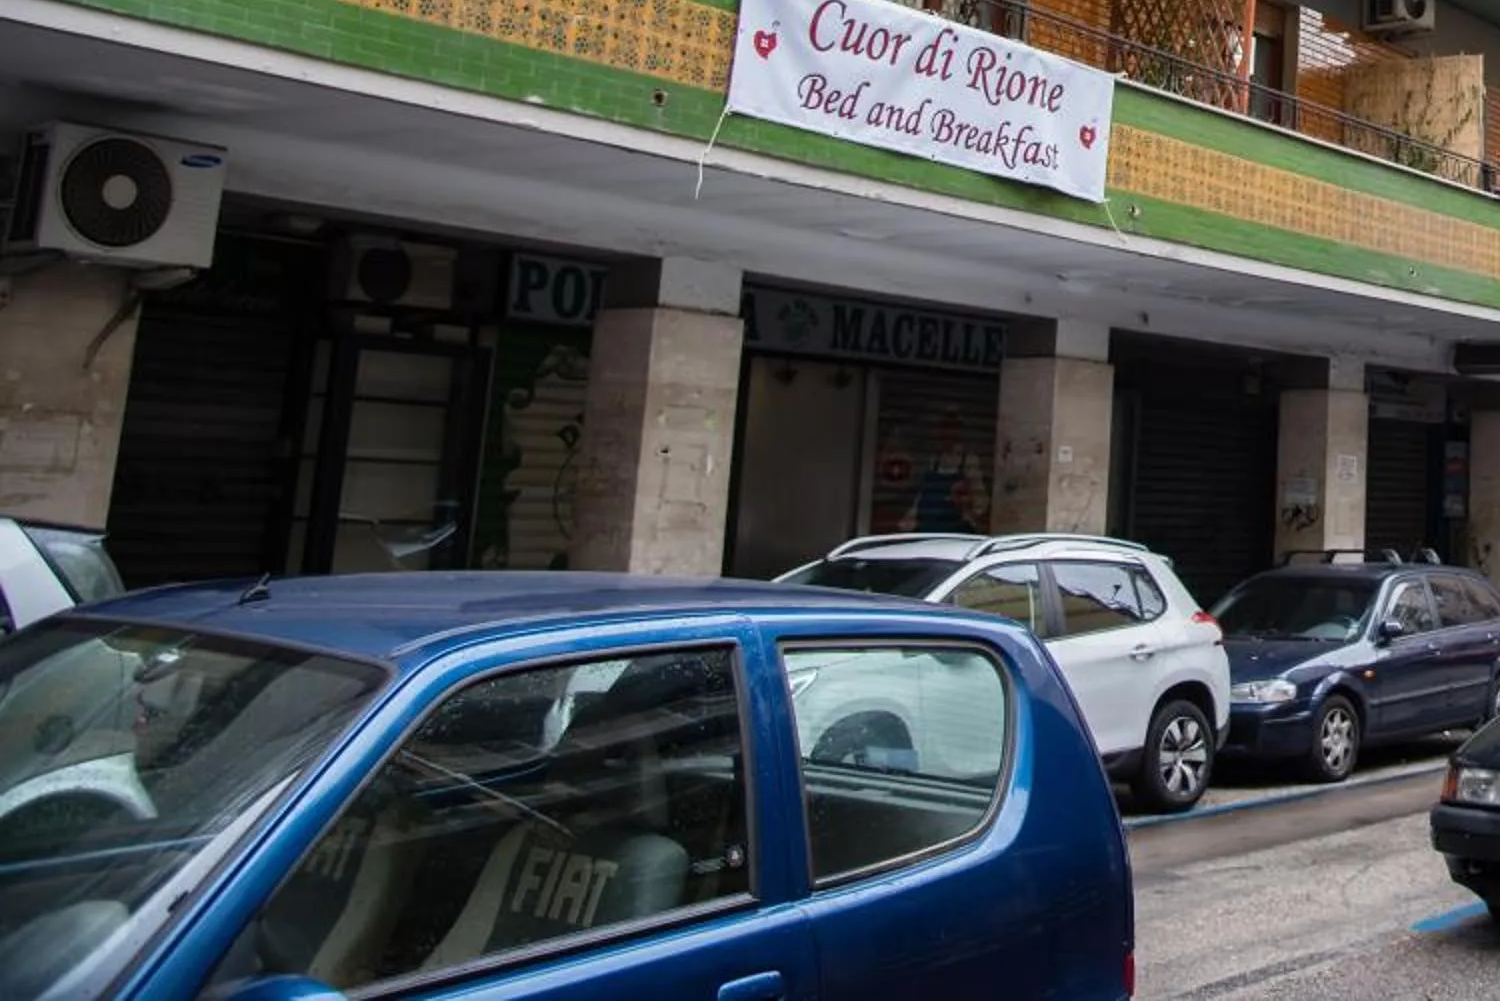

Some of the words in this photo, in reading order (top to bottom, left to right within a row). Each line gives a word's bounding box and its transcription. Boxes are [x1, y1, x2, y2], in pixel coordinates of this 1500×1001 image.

[915, 28, 959, 81] di
[966, 46, 1064, 113] Rione
[797, 74, 871, 120] Bed
[866, 99, 933, 136] and
[930, 108, 1059, 170] Breakfast
[511, 847, 619, 929] FIAT
